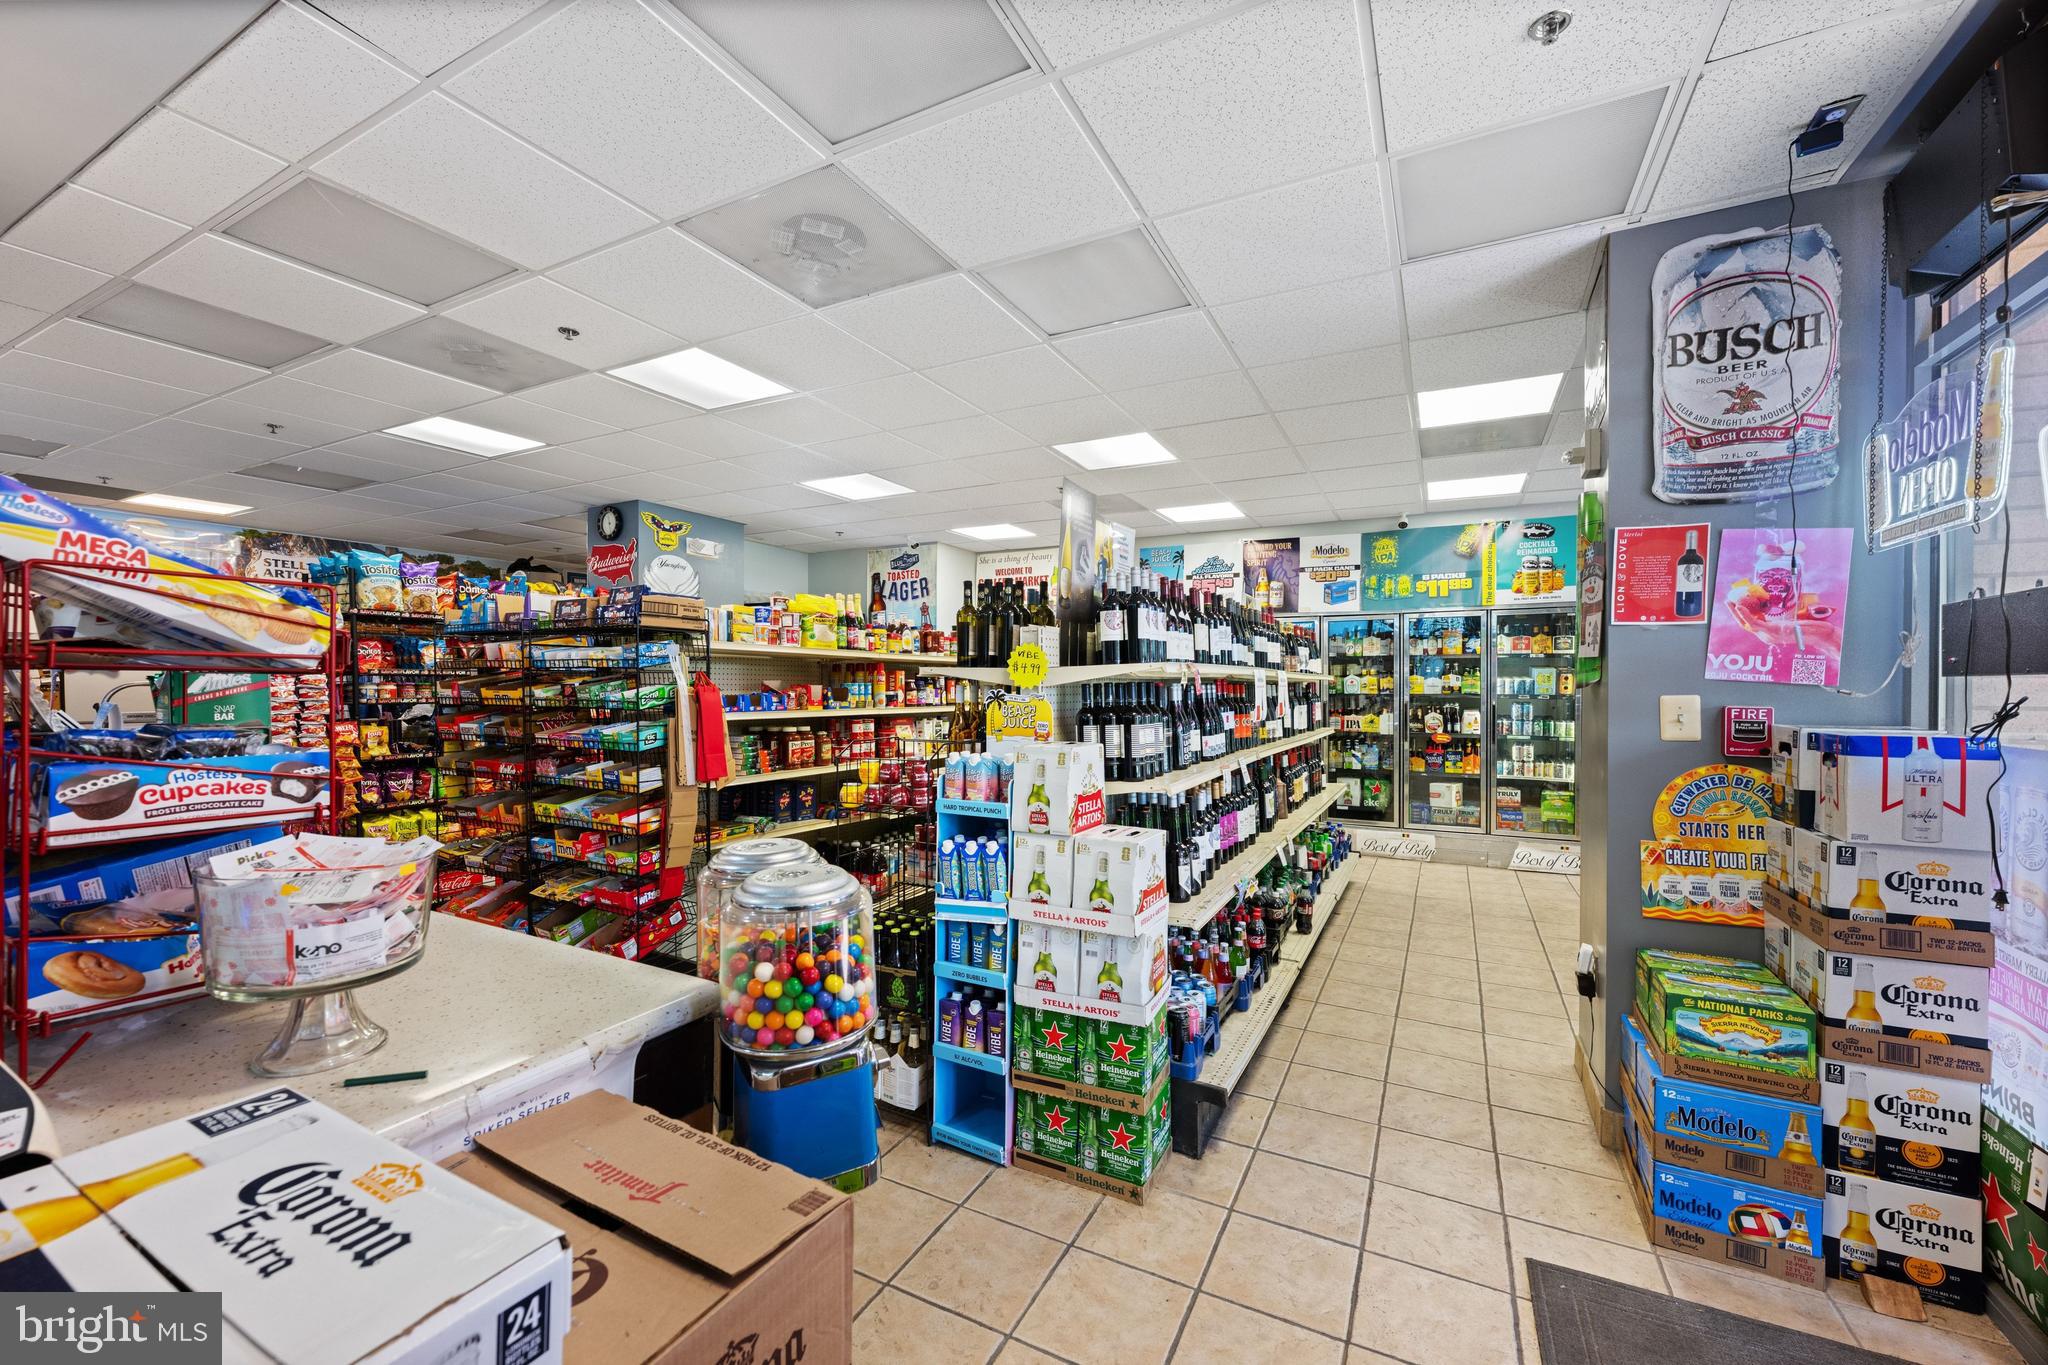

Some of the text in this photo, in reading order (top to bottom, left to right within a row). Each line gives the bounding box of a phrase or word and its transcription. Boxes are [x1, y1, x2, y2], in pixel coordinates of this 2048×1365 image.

[1667, 311, 1827, 368] BUSCH
[1717, 360, 1768, 375] BEER
[1695, 371, 1758, 386] PRODUCT OF
[1675, 402, 1692, 418] CLEAR
[1693, 413, 1709, 425] AND
[1711, 417, 1743, 427] BRIGHT
[1746, 415, 1758, 425] AS
[1759, 395, 1801, 424] MOUNTAIN
[1801, 385, 1814, 399] AIR
[1701, 428, 1736, 447] BUSCH
[1740, 427, 1785, 440] CLASSIC
[1720, 452, 1729, 460] 12
[59, 531, 147, 568] MEGA
[1275, 542, 1292, 551] YOUR
[1315, 544, 1345, 556] Modelo
[1516, 547, 1558, 556] REIMAGINED
[1519, 541, 1556, 549] COCKTAILS
[587, 551, 637, 572] Budweiser
[979, 554, 1022, 566] She thing
[1151, 555, 1172, 563] JUICE
[1247, 558, 1267, 567] SPIRIT
[1376, 552, 1393, 564] IPA
[887, 568, 920, 582] TOASTED
[995, 566, 1033, 577] WELCOME TO
[1616, 538, 1628, 613] LION DOVE
[402, 575, 437, 586] Tostitos
[880, 576, 931, 602] LAGER
[1707, 654, 1774, 672] YOJU
[1730, 672, 1775, 682] COCKTAIL
[214, 704, 236, 713] SNAP
[214, 712, 235, 721] BAR
[1001, 704, 1037, 717] BEACH
[1731, 708, 1768, 720] FIRE
[537, 710, 576, 731] Twix
[1001, 715, 1036, 729] JUICE
[1345, 720, 1361, 730] IPA
[173, 769, 237, 784] Hostess
[1904, 774, 1944, 785] ULTRA
[139, 780, 268, 806] Cupcakes
[1670, 773, 1729, 817] CUTWATER
[1732, 774, 1755, 790] DE
[146, 800, 263, 817] FROSTED CHOCOLATE CAKE
[943, 803, 1002, 815] HARD TROPICAL PUNCH
[1077, 799, 1102, 815] STELLA
[1688, 790, 1727, 816] TEQUILA
[1076, 810, 1102, 828] ARTOIS
[1679, 822, 1765, 841] STARTS HER
[1362, 839, 1404, 859] Best of
[1840, 845, 1852, 857] 12
[237, 852, 263, 867] Pick
[1514, 851, 1562, 871] Best of
[1665, 849, 1747, 870] CREATE YOUR
[1719, 883, 1740, 892] TEQUILA
[1884, 870, 1985, 897] Corona
[1142, 888, 1166, 909] STELLA
[1719, 890, 1741, 899] PALOMA
[1910, 890, 1959, 908] Extra
[1033, 910, 1106, 928] STELLA ARTOIS
[1852, 912, 1884, 924] Corona
[1833, 931, 1876, 943] Corona
[1843, 939, 1865, 948] Extra
[1930, 937, 1983, 949] TWO 12-PACKS
[1957, 946, 1986, 954] BOTTLES
[1837, 957, 1848, 968] 12
[952, 970, 988, 983] ZERO BUBBLES
[1880, 983, 1981, 1013] Corona
[1042, 998, 1118, 1018] STELLA ARTOIS
[1698, 1000, 1807, 1024] NATIONAL PARKS Series
[1906, 1005, 1955, 1023] Extra
[1710, 1020, 1770, 1037] SIERRA NEVADA
[1832, 1040, 1874, 1055] Corona
[1842, 1049, 1863, 1059] Extra
[1035, 1050, 1072, 1064] Heineken
[1928, 1053, 1981, 1068] TWO 12-PACKS
[1100, 1062, 1140, 1078] Heineken
[1683, 1063, 1786, 1089] SIERRA NEVADA BREWING
[1829, 1065, 1841, 1076] 12
[1956, 1063, 1985, 1074] BOTTLES
[1075, 1088, 1125, 1107] Heineken
[1662, 1089, 1677, 1099] 12
[241, 1092, 297, 1117] 24
[1874, 1093, 1974, 1127] Corona
[464, 1091, 571, 1147] SPIKED SELTZER
[1678, 1106, 1757, 1142] Modelo
[1900, 1116, 1948, 1136] Extra
[643, 1113, 773, 1173] 12 PACK OF 32 BOTTLES
[1037, 1131, 1073, 1148] Heineken
[1841, 1131, 1874, 1145] Corona
[1664, 1138, 1705, 1158] Modelo
[1101, 1149, 1139, 1167] Heineken
[582, 1159, 688, 1205] Familiar
[1075, 1172, 1125, 1196] Heineken
[1660, 1172, 1675, 1184] 12
[1830, 1176, 1842, 1187] 12
[1659, 1189, 1722, 1221] Modelo
[237, 1160, 413, 1270] Corona
[1875, 1207, 1975, 1245] Corona
[207, 1205, 295, 1280] Extra
[1664, 1224, 1705, 1245] Modelo
[1901, 1229, 1949, 1254] Extra
[1842, 1243, 1875, 1259] Corona
[1785, 1259, 1816, 1273] 12-PACKS
[1785, 1271, 1815, 1284] BOTTLES
[506, 1295, 542, 1346] 24
